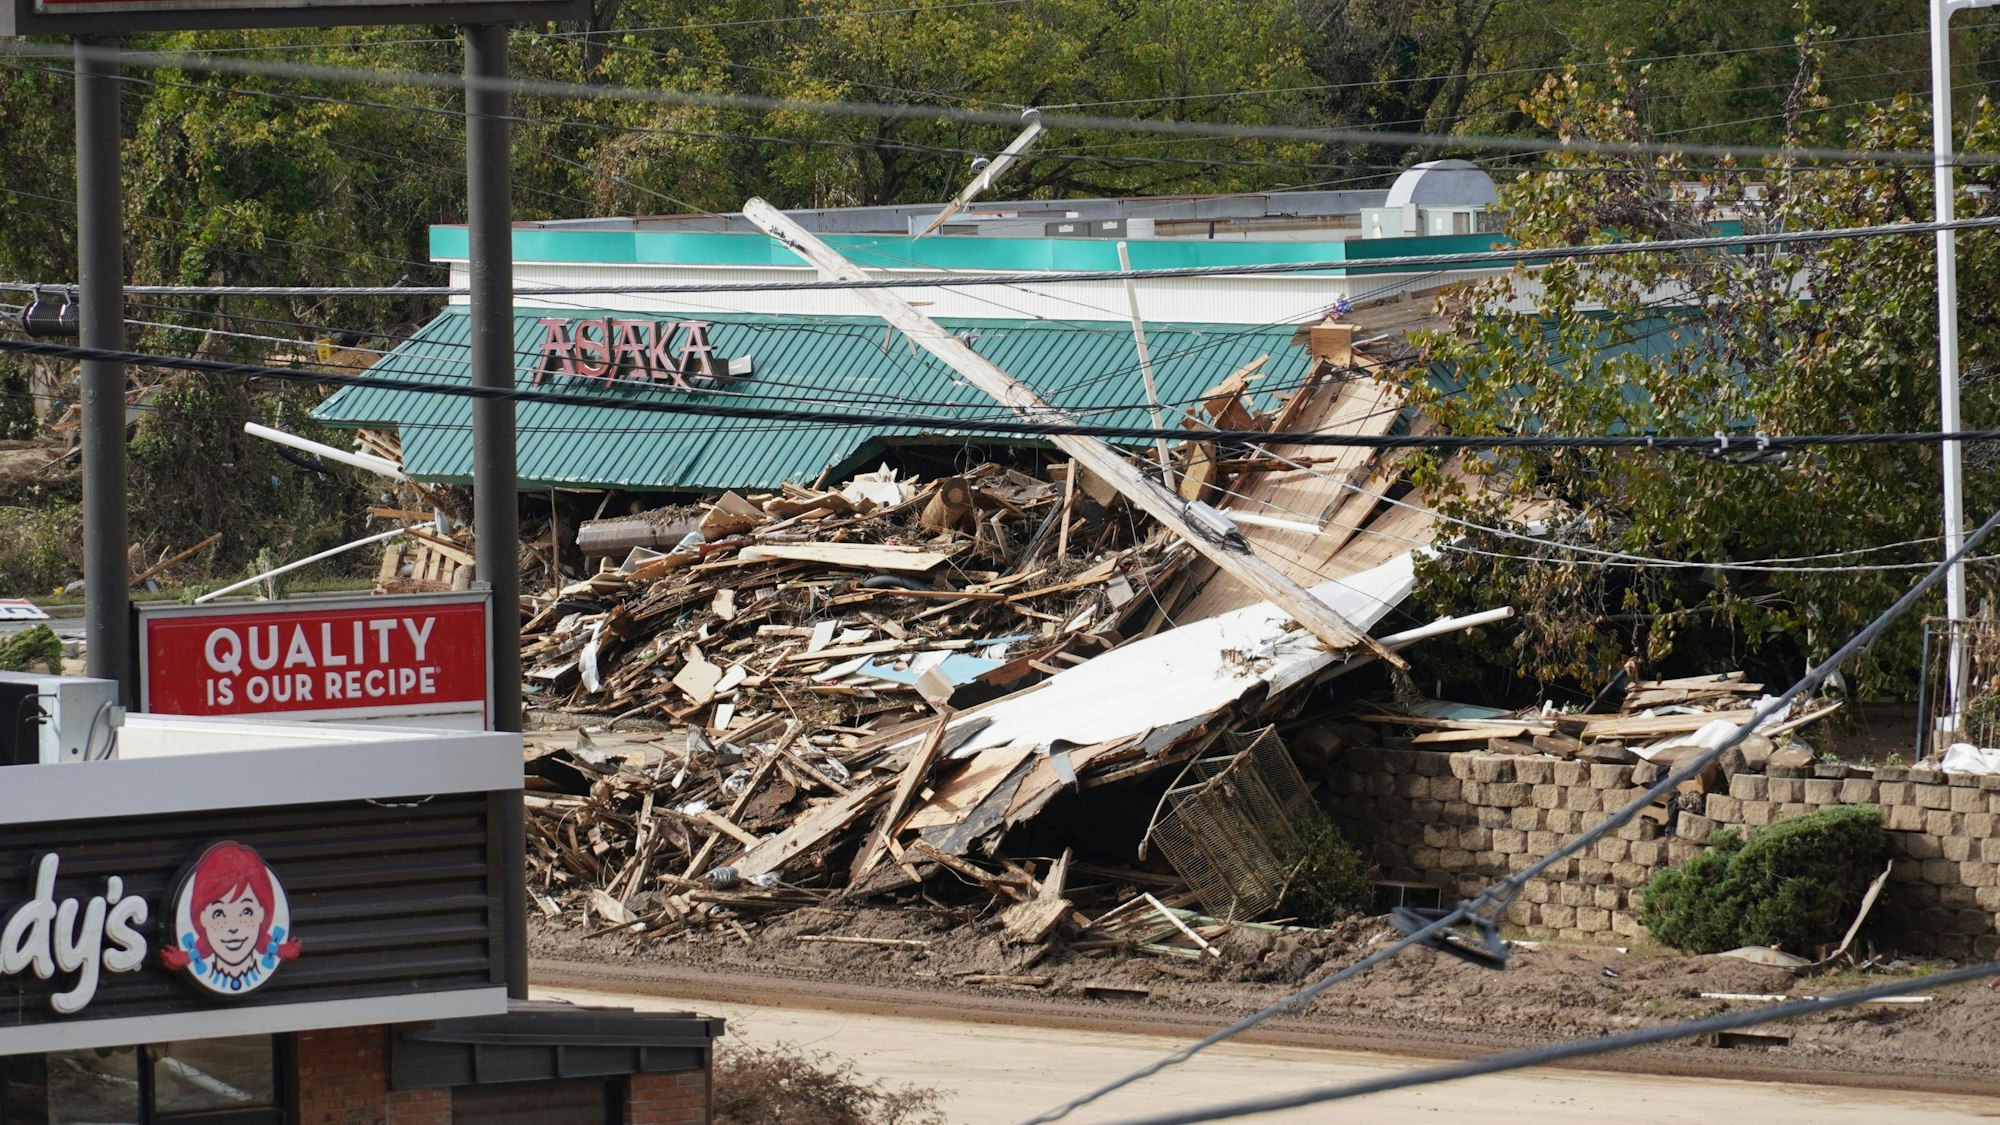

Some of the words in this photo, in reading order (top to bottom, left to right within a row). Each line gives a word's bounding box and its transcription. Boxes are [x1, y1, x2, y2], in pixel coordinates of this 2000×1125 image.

[531, 317, 715, 393] ASAKA
[204, 616, 437, 677] QUALITY
[206, 677, 235, 707] IS
[246, 673, 314, 705] OUR
[0, 852, 148, 1014] dy's
